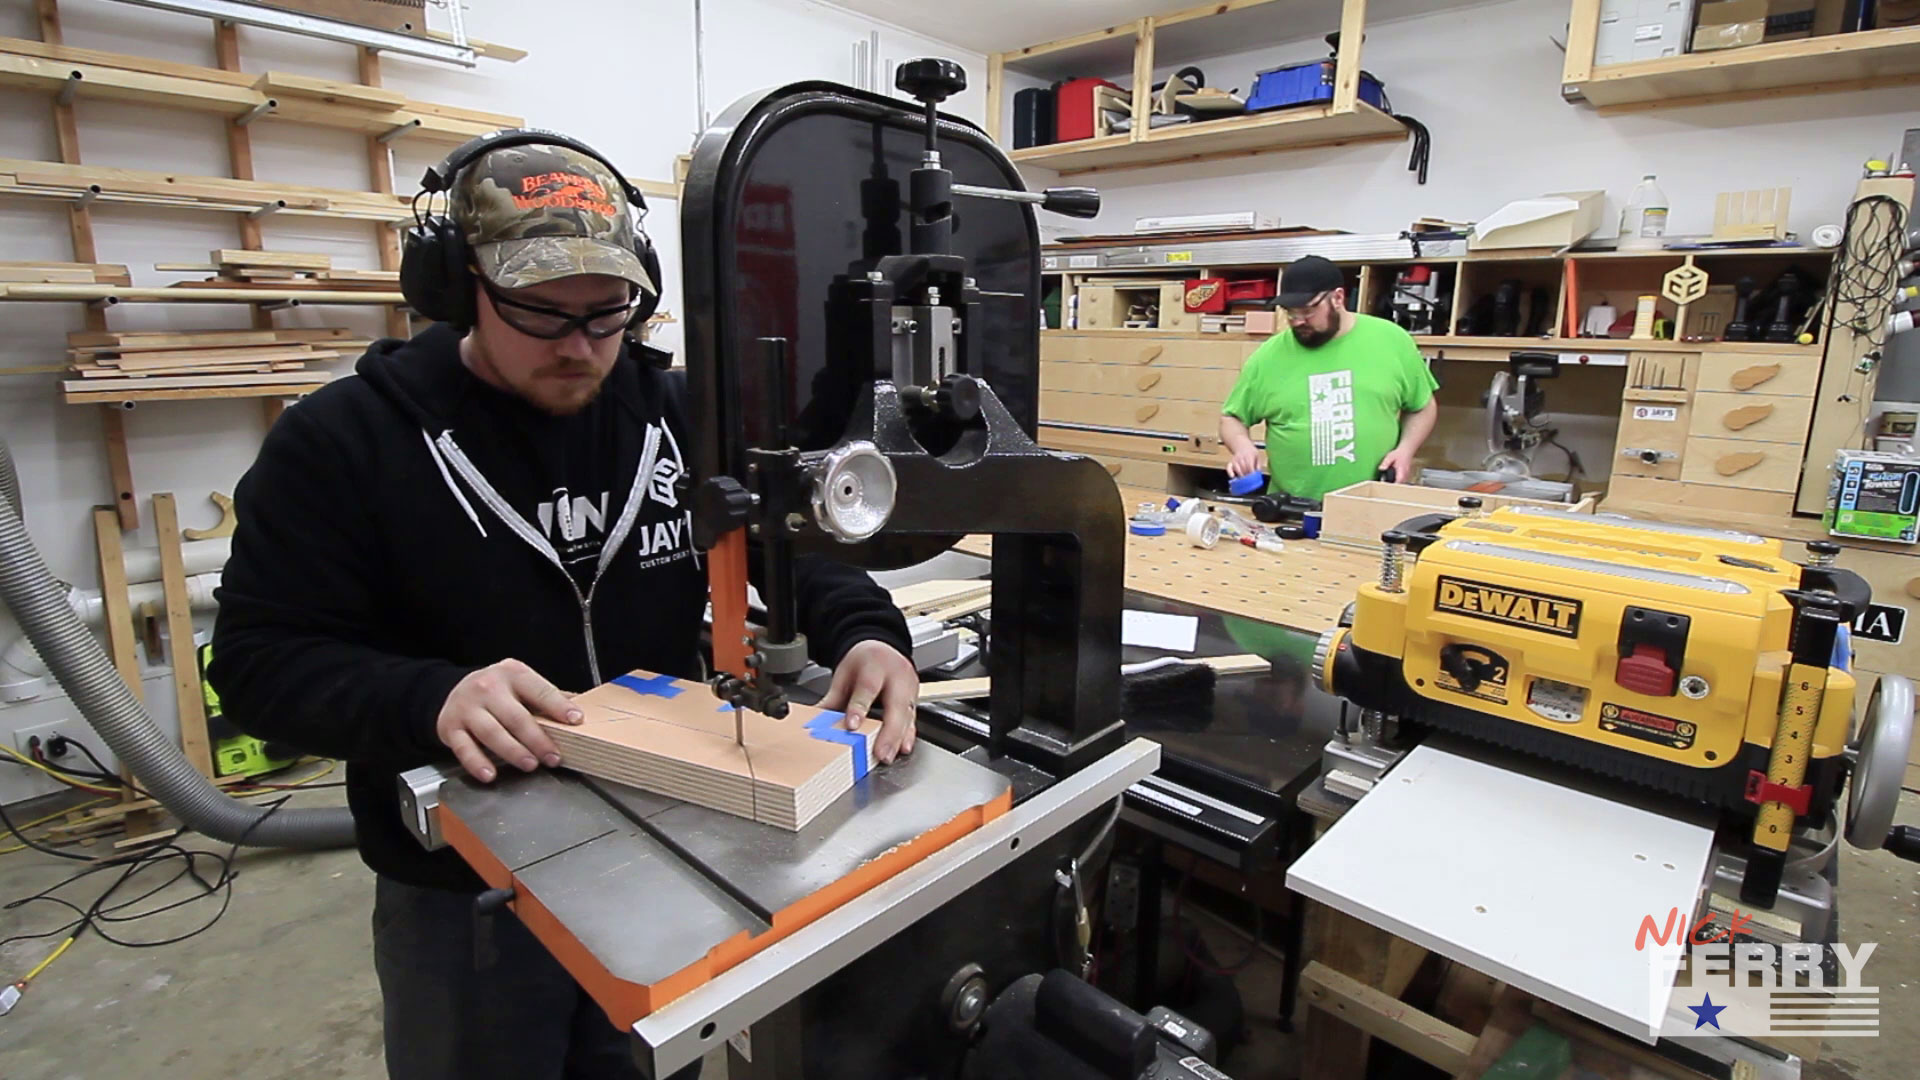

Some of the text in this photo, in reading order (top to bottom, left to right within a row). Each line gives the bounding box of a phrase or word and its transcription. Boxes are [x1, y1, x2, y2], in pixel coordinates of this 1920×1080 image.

[1330, 370, 1355, 463] FERRY
[1493, 666, 1505, 683] 2
[1801, 681, 1809, 691] 6
[1796, 705, 1804, 715] 5
[1791, 730, 1799, 740] 4
[1785, 754, 1793, 764] 3
[1769, 824, 1777, 833] 0
